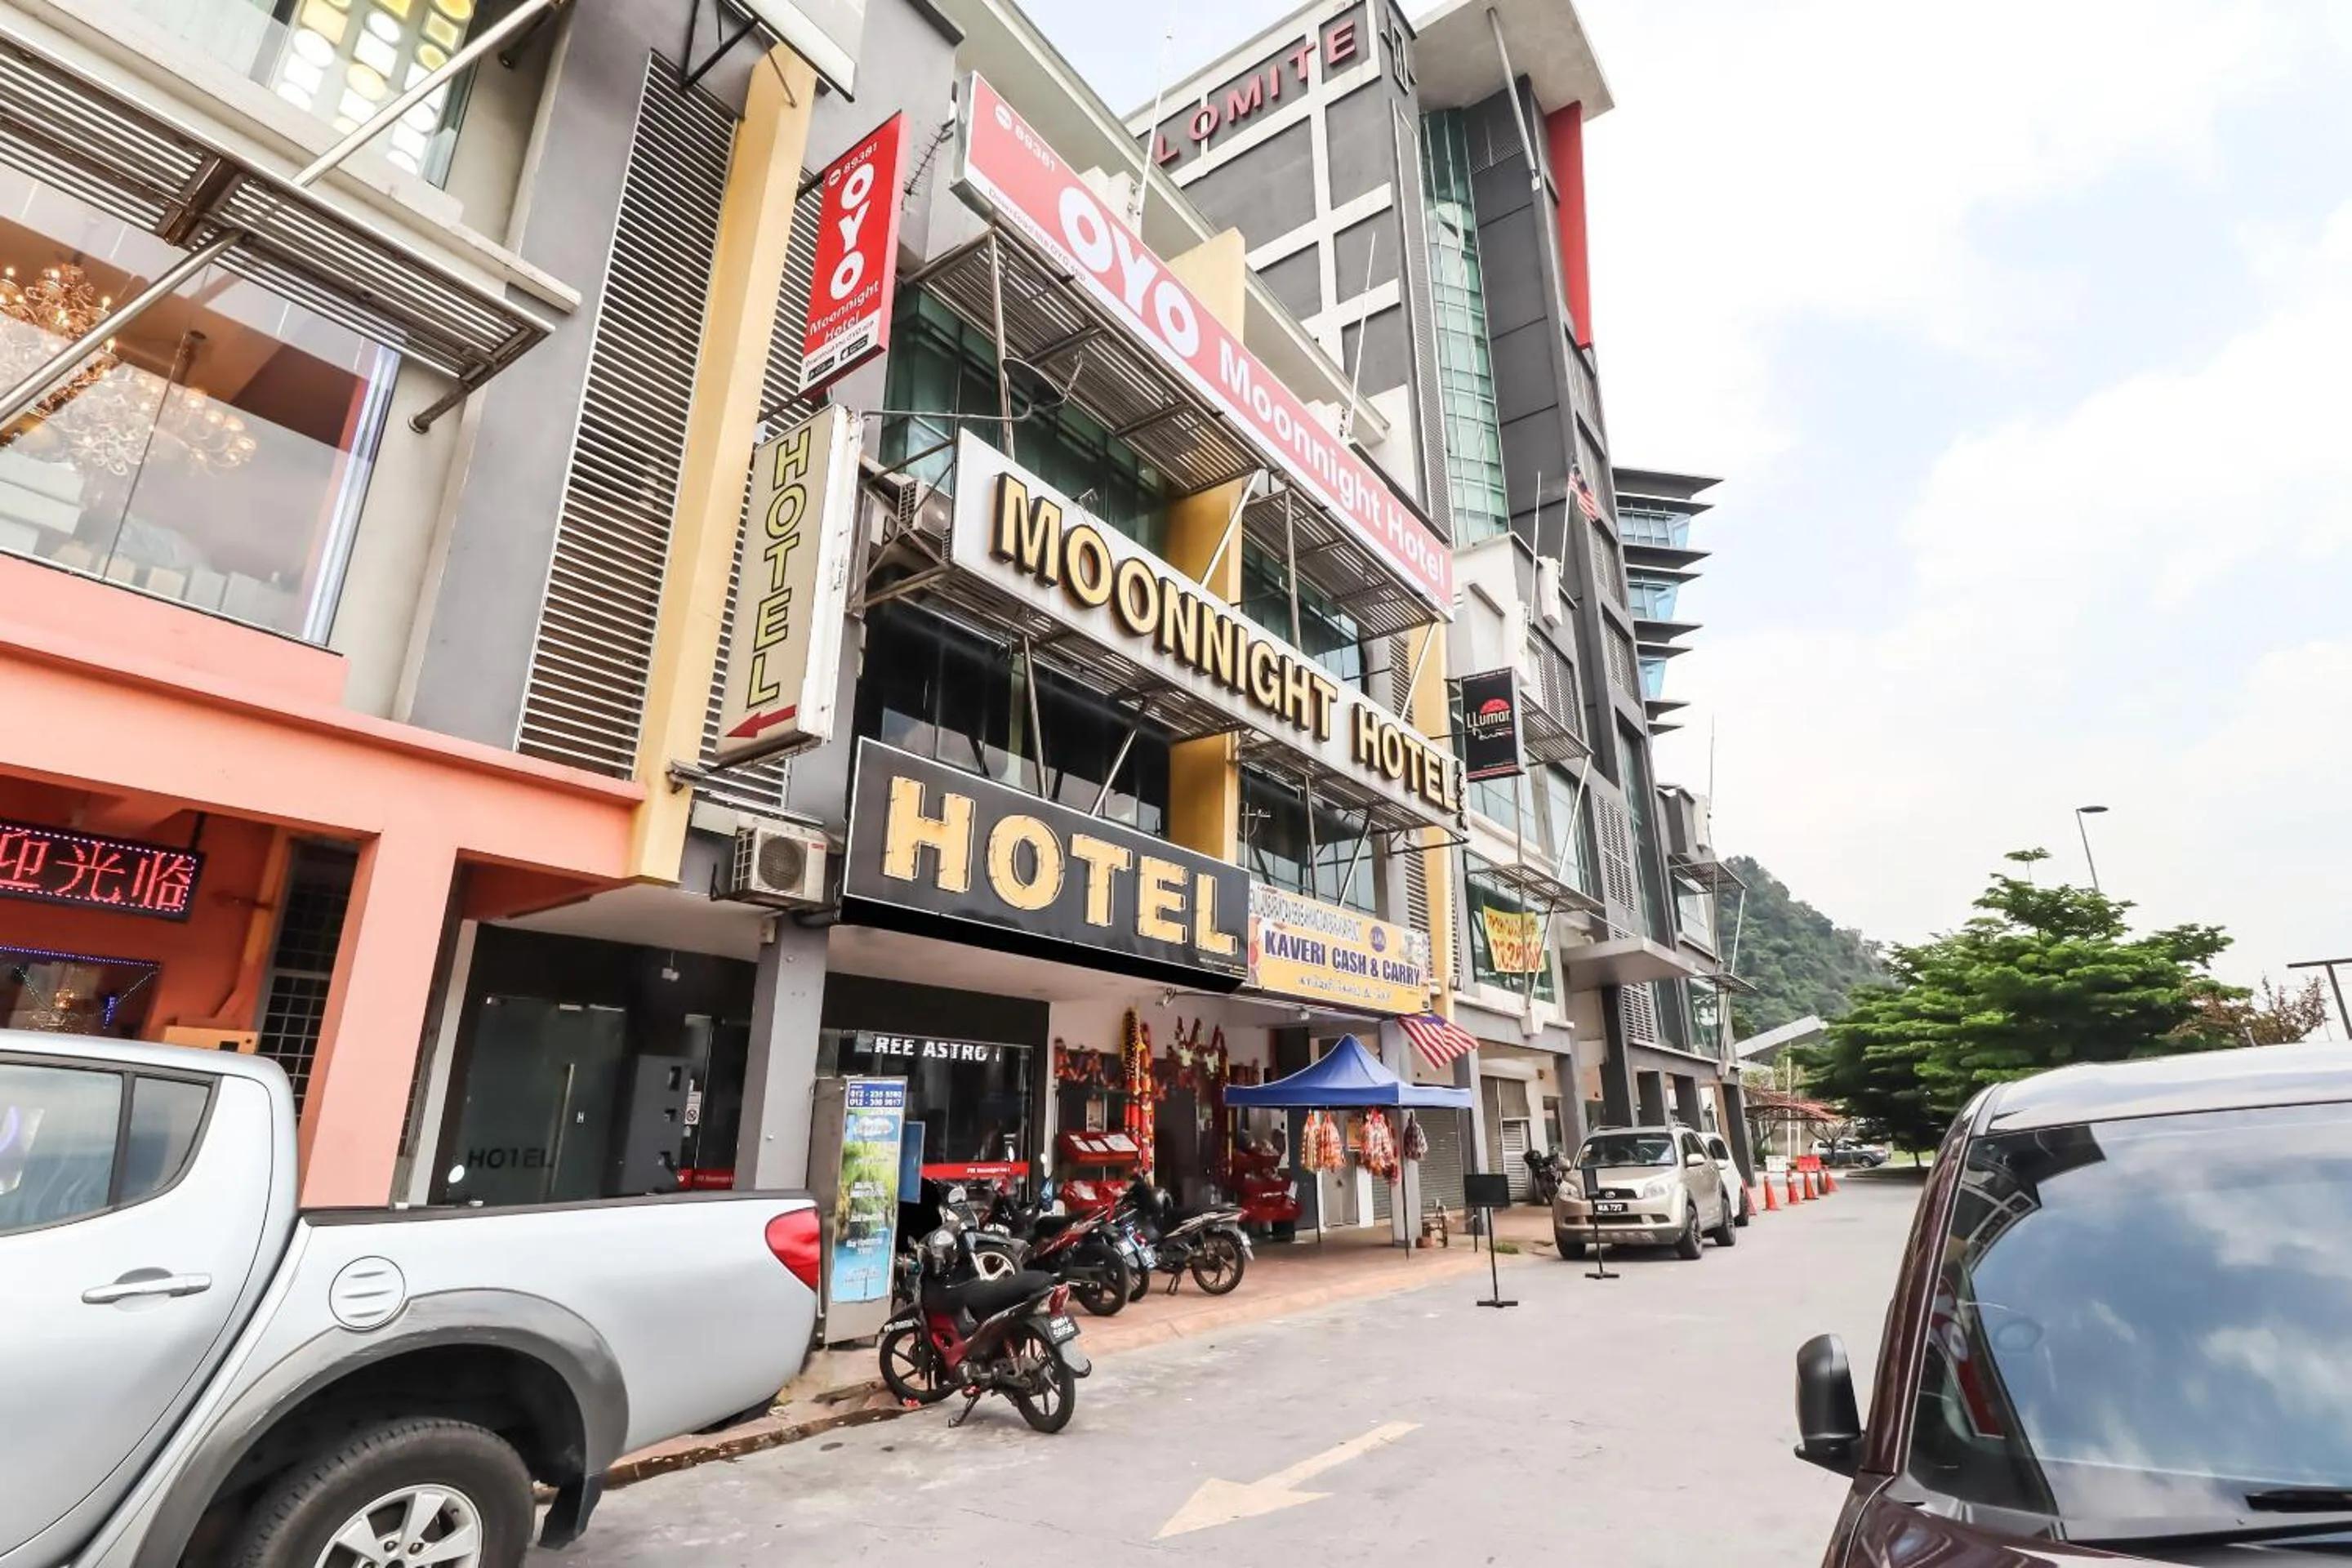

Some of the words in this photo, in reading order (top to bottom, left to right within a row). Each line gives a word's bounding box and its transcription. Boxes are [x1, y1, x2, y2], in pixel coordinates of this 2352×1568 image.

[1153, 20, 1356, 165] LOMITE
[830, 163, 875, 300] OYO
[809, 281, 880, 336] Moonnight
[824, 310, 861, 345] Hotel
[1058, 186, 1200, 359] OYO
[1219, 336, 1383, 528] Moonnight
[1388, 502, 1446, 590] Hotel
[746, 425, 812, 710] HOTEL
[993, 470, 1338, 742] MOONNIGHT
[1354, 702, 1458, 814] HOTEL
[881, 776, 1237, 956] HOTEL
[1264, 929, 1325, 966] KAVERI
[1332, 947, 1366, 975] CASH
[1370, 956, 1379, 977] &
[1382, 959, 1420, 987] CARRY
[467, 1147, 554, 1169] HOTEL
